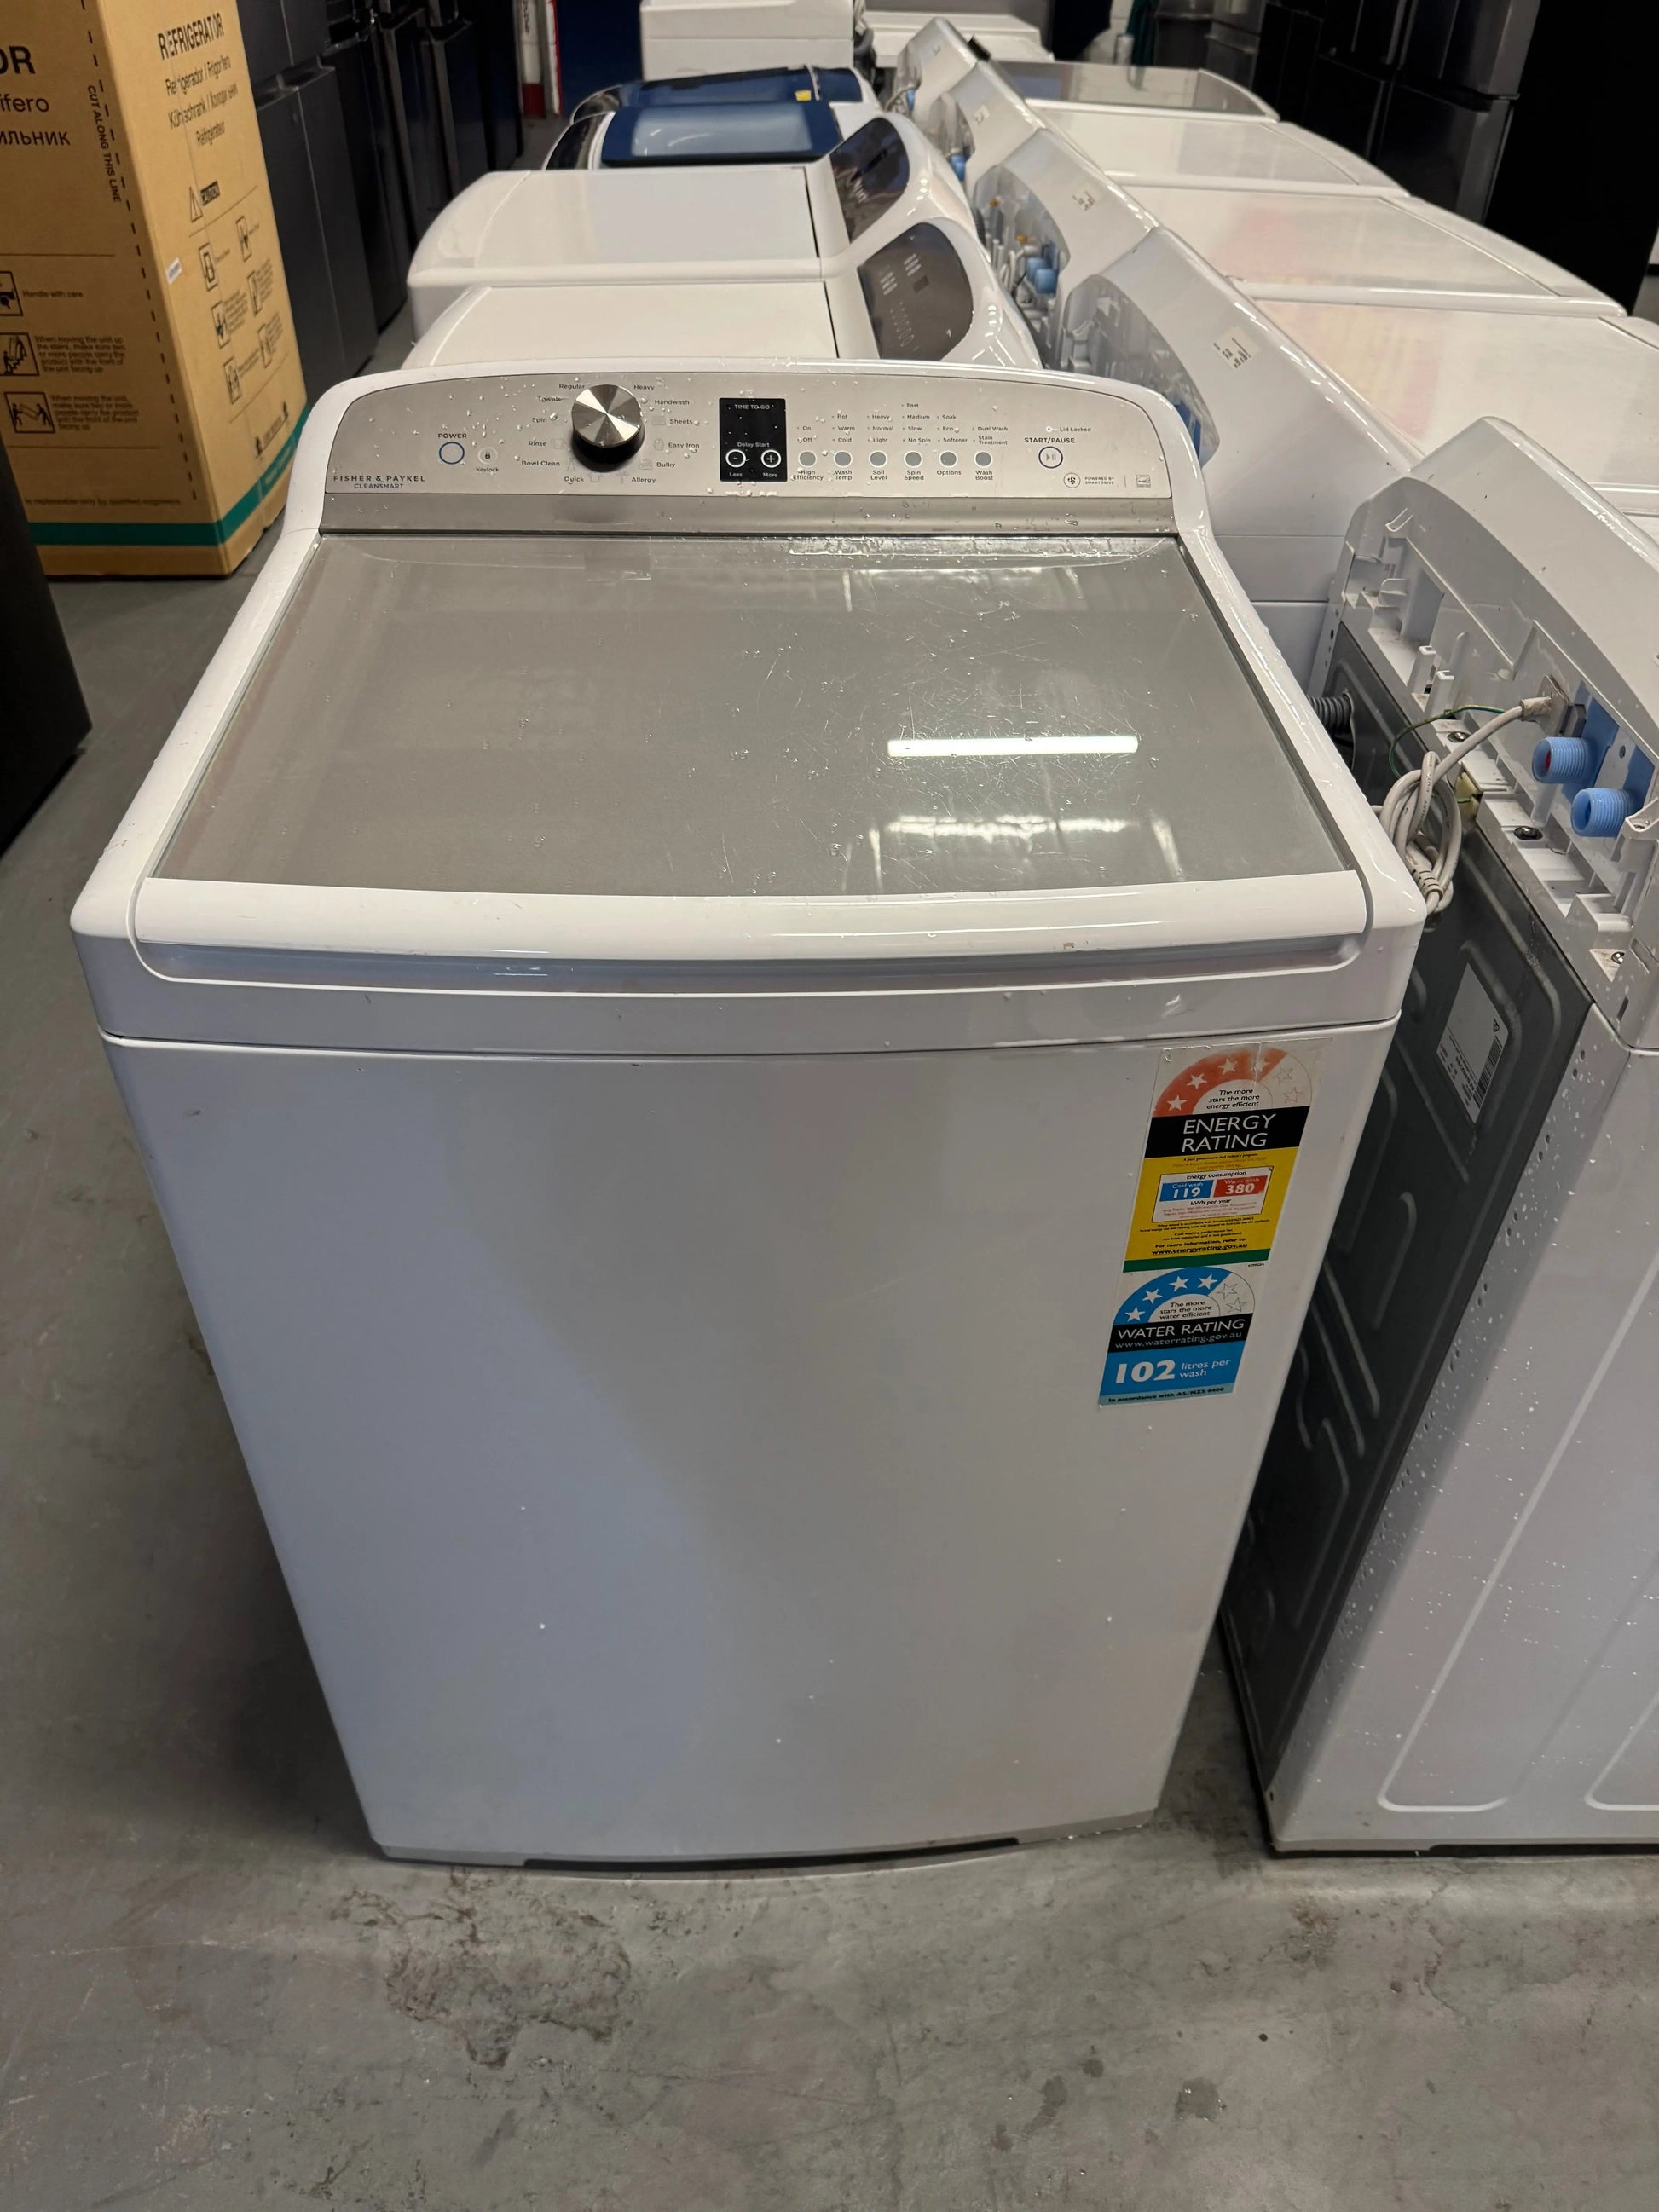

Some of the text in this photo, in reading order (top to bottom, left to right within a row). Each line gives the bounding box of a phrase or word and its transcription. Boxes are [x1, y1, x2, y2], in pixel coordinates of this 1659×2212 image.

[158, 12, 224, 60] REFRIGERATOR
[88, 85, 121, 202] CUT ALONG THIS LINE
[1183, 1113, 1276, 1135] ENERGY
[1182, 1133, 1268, 1152] RATING
[1173, 1187, 1201, 1198] 119
[1225, 1183, 1255, 1194] 380
[1152, 1244, 1247, 1256] www.energyrating.gov.au
[1118, 1320, 1246, 1339] WATER RATING
[1115, 1331, 1242, 1349] www.waterrating.gov.au
[1115, 1360, 1176, 1384] 102
[1182, 1359, 1231, 1370] litres per
[1179, 1370, 1207, 1378] wash
